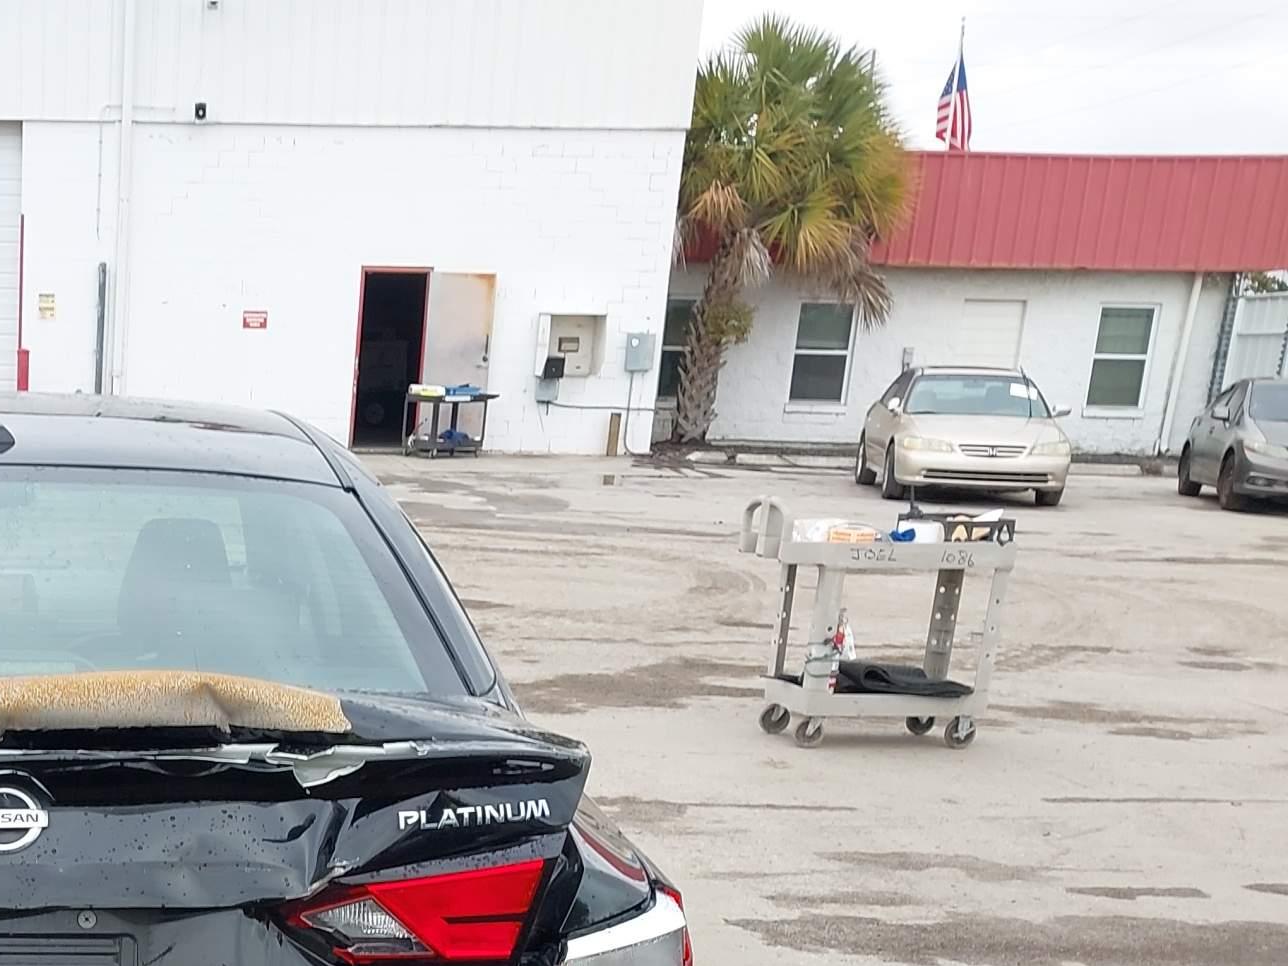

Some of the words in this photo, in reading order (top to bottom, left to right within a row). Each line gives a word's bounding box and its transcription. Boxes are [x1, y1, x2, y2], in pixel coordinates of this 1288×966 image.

[850, 548, 897, 561] JOEL
[940, 549, 975, 568] 1086
[398, 799, 551, 830] PLATINUM
